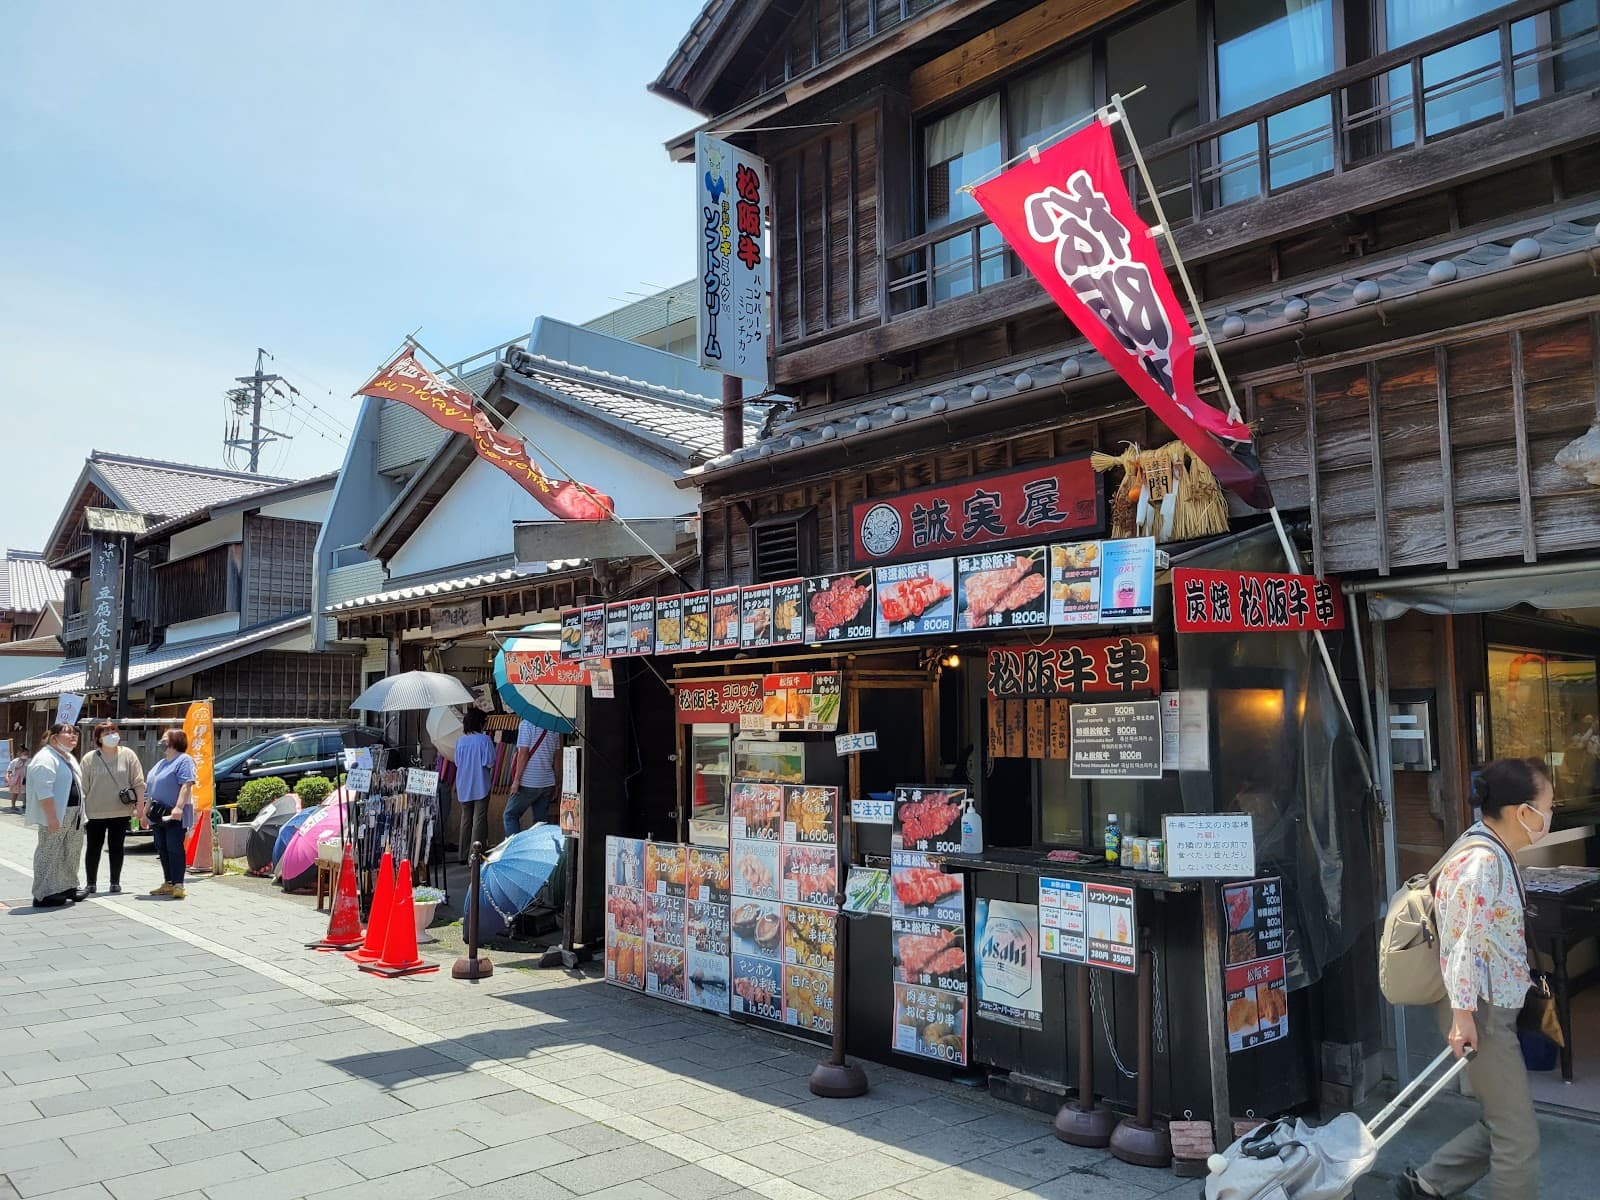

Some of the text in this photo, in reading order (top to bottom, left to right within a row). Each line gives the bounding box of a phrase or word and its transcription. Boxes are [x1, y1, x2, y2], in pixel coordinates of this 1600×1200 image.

[736, 163, 761, 270] 松阪牛
[704, 206, 721, 360] ソフトクリーム
[738, 295, 747, 366] ミンチカツ
[910, 476, 1070, 549] 誠実屋
[958, 553, 1016, 572] 極上松阪牛
[877, 566, 930, 584] 特選松阪牛
[808, 578, 830, 592] 上串
[1184, 576, 1336, 626] 炭焼 松阪牛串
[923, 618, 950, 631] 800円
[1011, 611, 1045, 624] 1200円
[92, 586, 114, 672] 豆腐庵山中
[848, 625, 872, 638] 500円
[988, 638, 1152, 697] 松阪牛串
[779, 678, 801, 687] 松阪牛
[678, 681, 760, 712] 松阪牛 コロッケ
[720, 699, 764, 714] メンチカツ
[897, 790, 922, 802] 上串
[853, 802, 892, 816] ご注文口
[809, 830, 835, 842] 600円
[936, 841, 961, 853] 500円
[655, 862, 680, 873] コロッケ
[692, 866, 730, 880] メンチカツ
[810, 892, 836, 905] 500円
[1090, 892, 1132, 905] ソフトクリーム
[937, 908, 961, 920] 800円
[892, 920, 941, 936] 極上松阪牛
[982, 935, 1026, 968] Asahi
[739, 960, 773, 977] マンボウ
[996, 962, 1005, 972] 生
[1248, 966, 1272, 983] 松阪牛
[791, 976, 828, 993] ほたての
[938, 976, 966, 992] 1200円
[906, 990, 938, 1007] 肉巻き
[757, 1002, 782, 1020] 500円
[906, 1006, 955, 1027] おにぎり串
[979, 1001, 1026, 1020] アサヒスーパードライ
[930, 1042, 963, 1062] 500円
